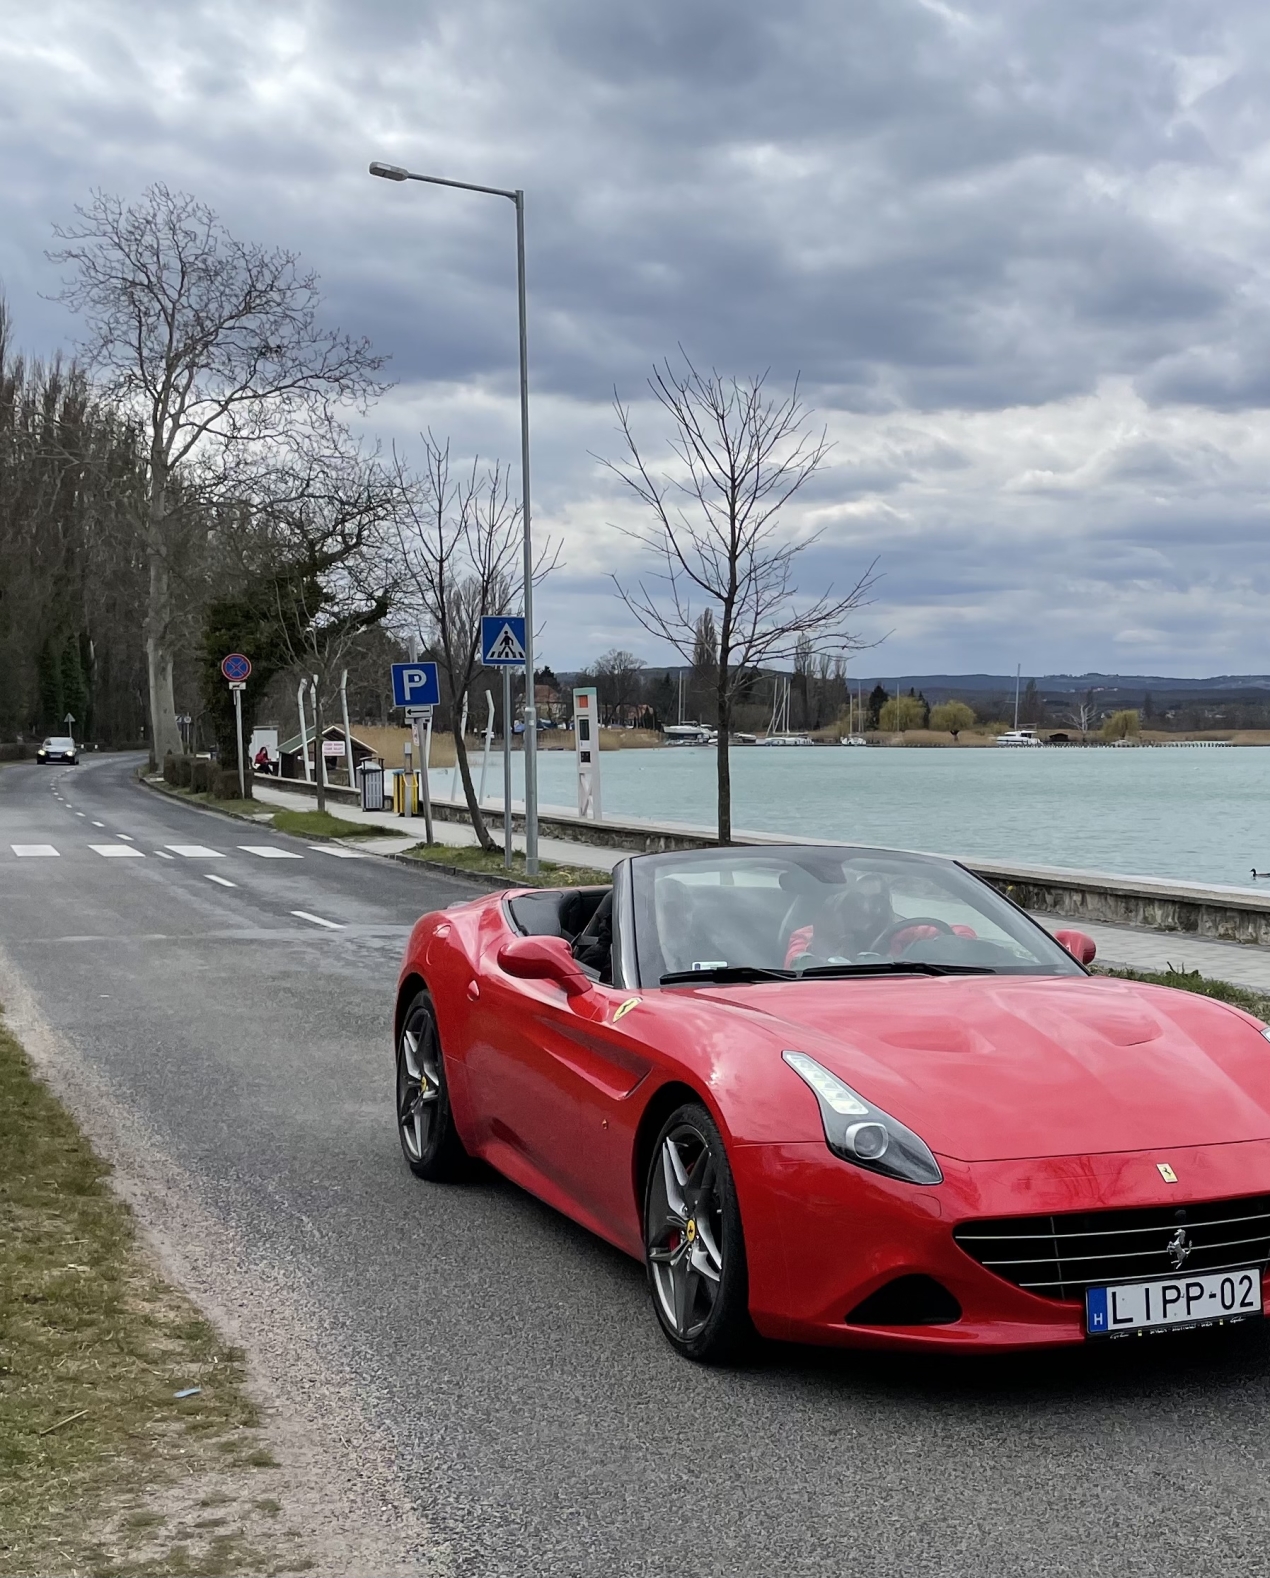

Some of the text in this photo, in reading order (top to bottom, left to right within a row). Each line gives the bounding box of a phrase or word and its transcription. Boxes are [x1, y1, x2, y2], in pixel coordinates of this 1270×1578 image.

[403, 669, 427, 700] P
[1111, 1274, 1254, 1325] LIPP-02
[1093, 1312, 1103, 1326] H
